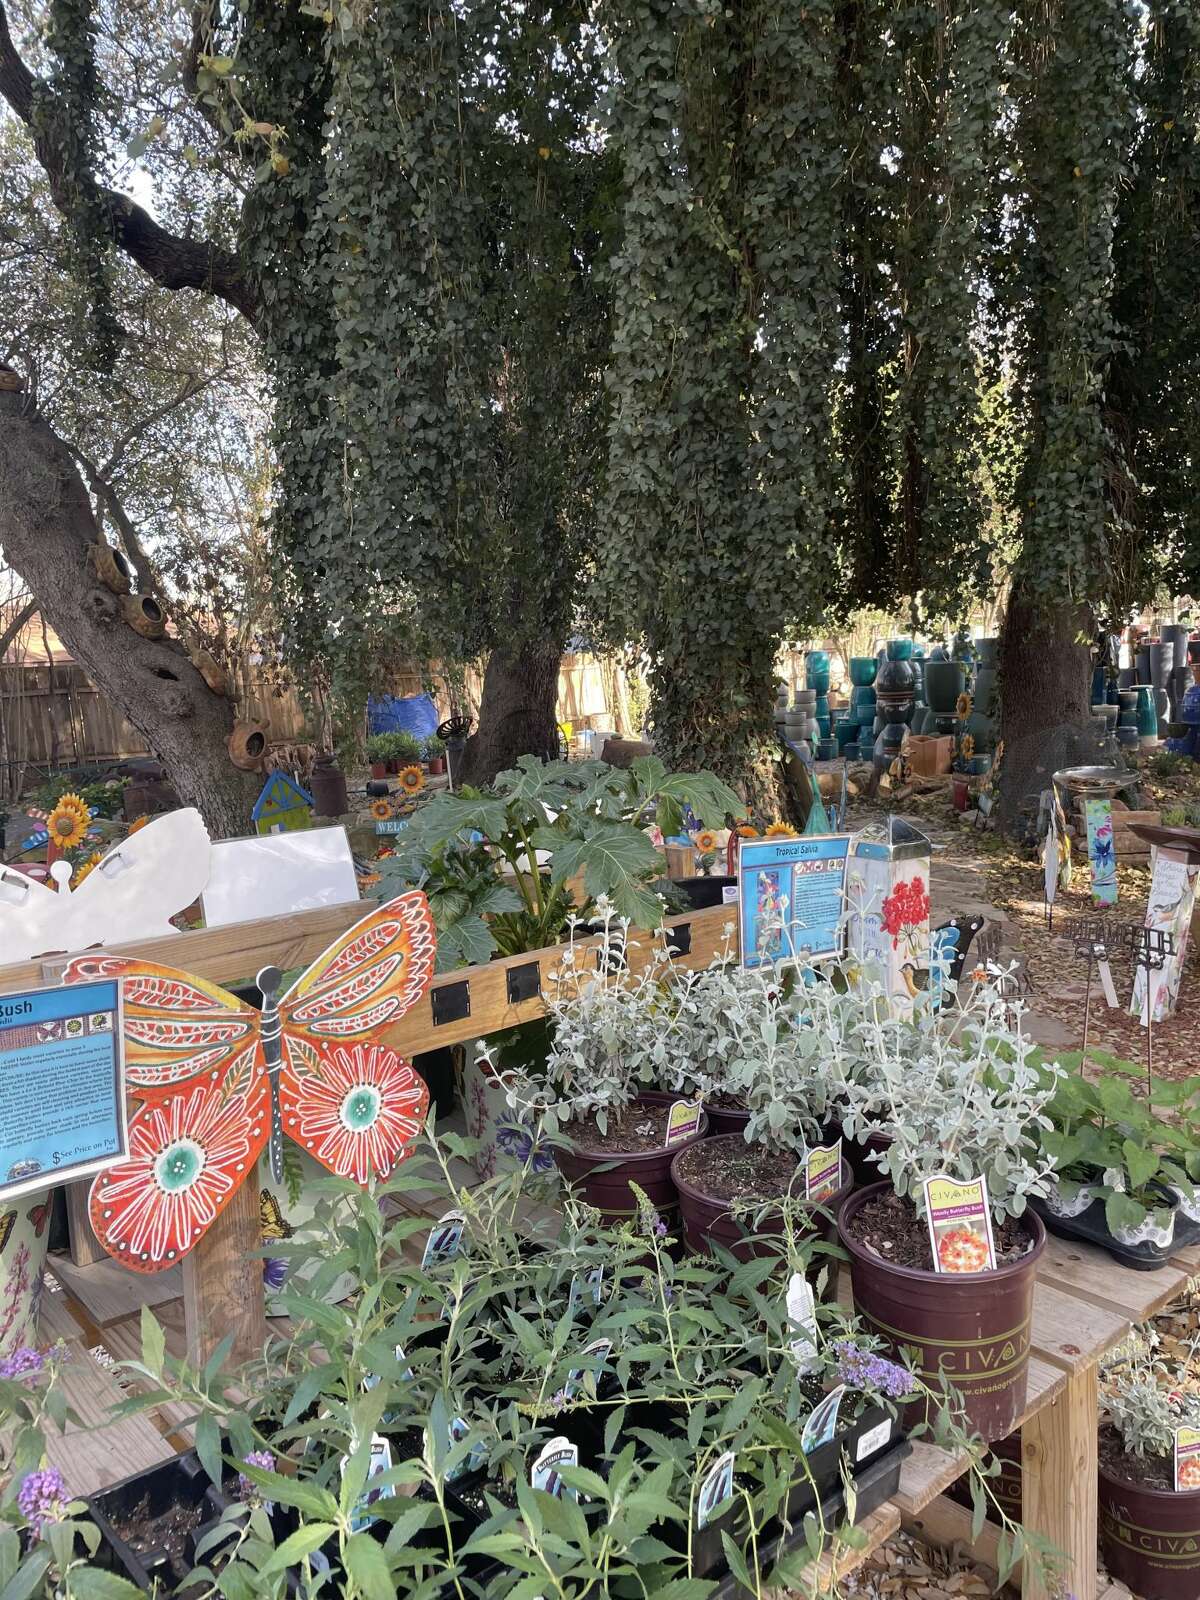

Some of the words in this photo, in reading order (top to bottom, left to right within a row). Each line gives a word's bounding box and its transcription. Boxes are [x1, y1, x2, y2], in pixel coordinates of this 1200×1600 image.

[379, 821, 409, 832] WELC
[776, 846, 799, 856] Tropical
[801, 845, 818, 854] Salvia
[74, 1145, 92, 1154] Price
[931, 1186, 979, 1200] CIVANO
